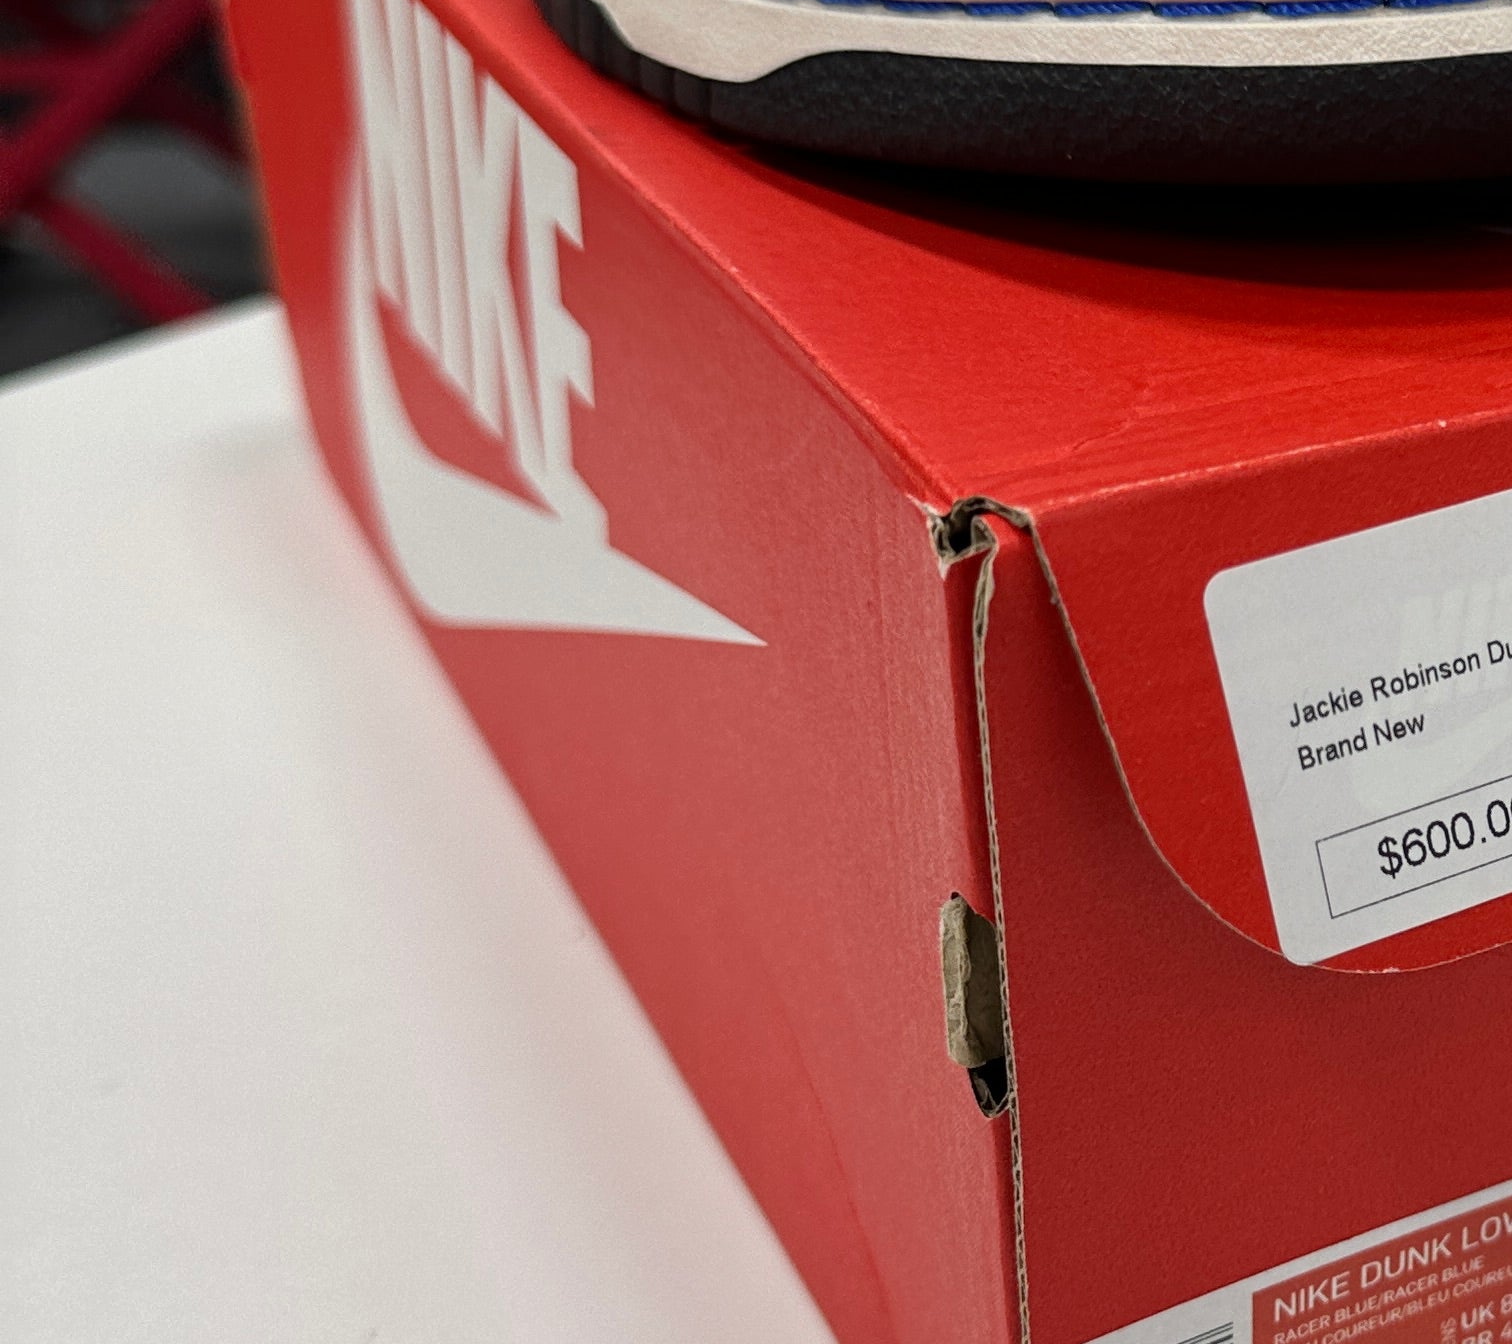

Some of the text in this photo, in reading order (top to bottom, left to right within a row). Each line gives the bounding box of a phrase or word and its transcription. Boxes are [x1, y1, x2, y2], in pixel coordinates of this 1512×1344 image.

[1290, 687, 1364, 728] Jackie
[1370, 652, 1481, 701] Robinson
[1297, 714, 1425, 771] Brand New
[1274, 1271, 1350, 1323] NIKE
[1361, 1233, 1452, 1289] DUNK
[1334, 1273, 1438, 1324] BLUE/RACER
[1442, 1255, 1485, 1282] BLUE
[1461, 1301, 1495, 1329] UK
